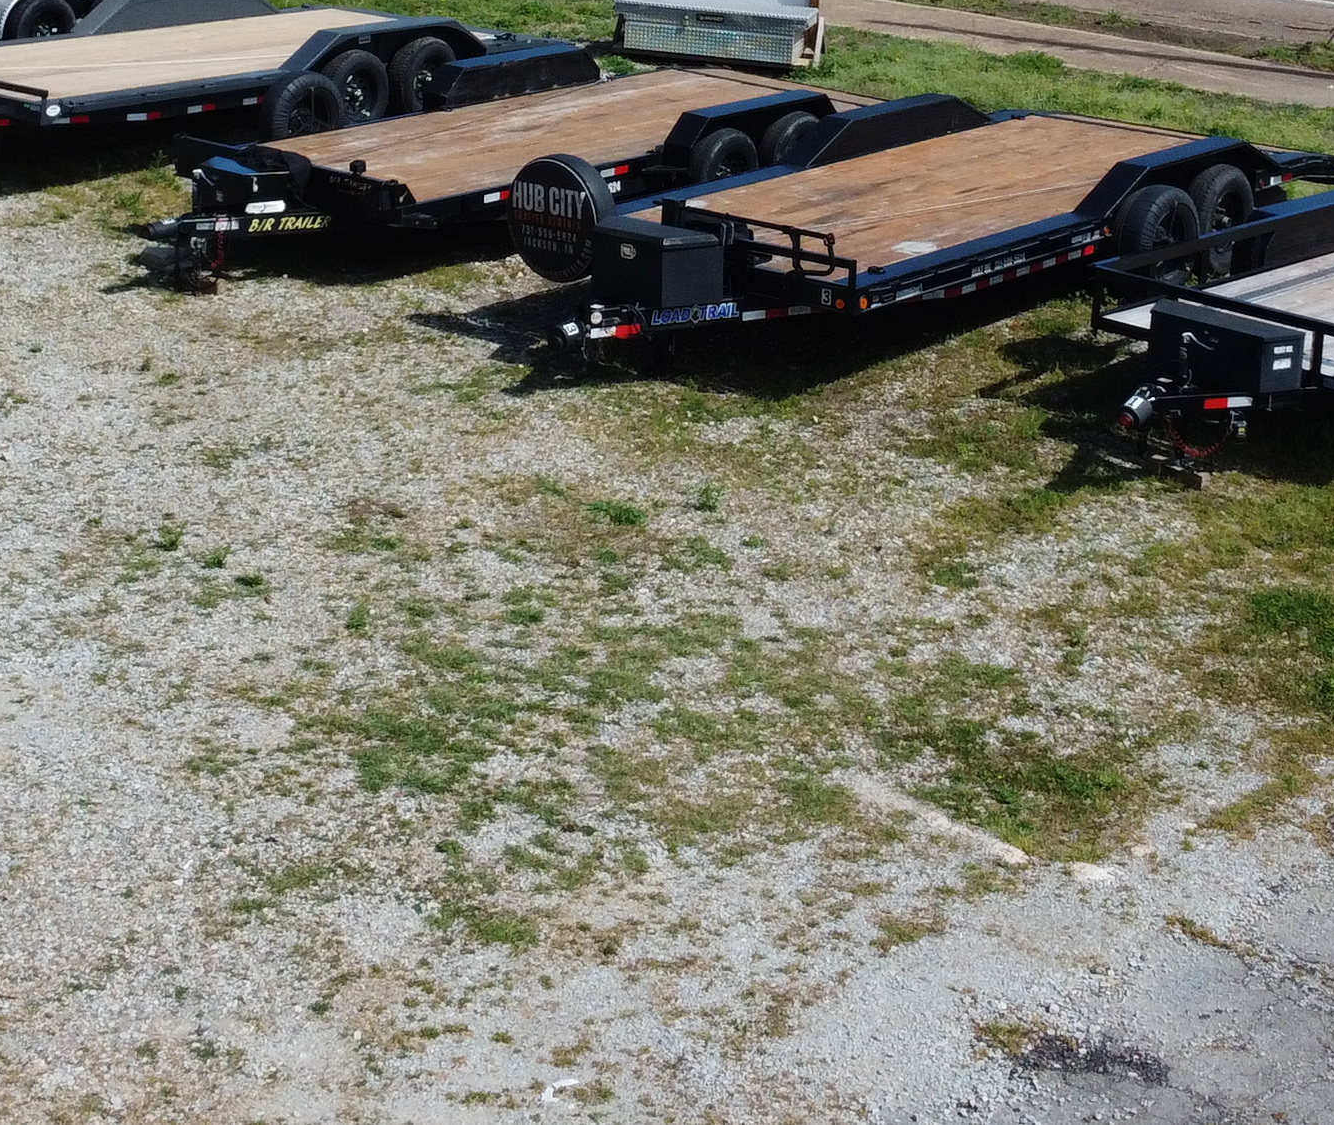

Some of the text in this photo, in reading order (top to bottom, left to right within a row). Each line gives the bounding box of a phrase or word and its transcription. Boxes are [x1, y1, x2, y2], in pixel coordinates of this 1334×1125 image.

[512, 180, 586, 220] HUB CITY
[248, 218, 274, 232] B/R
[823, 290, 831, 305] 3
[651, 302, 740, 326] LOAD TRAIL
